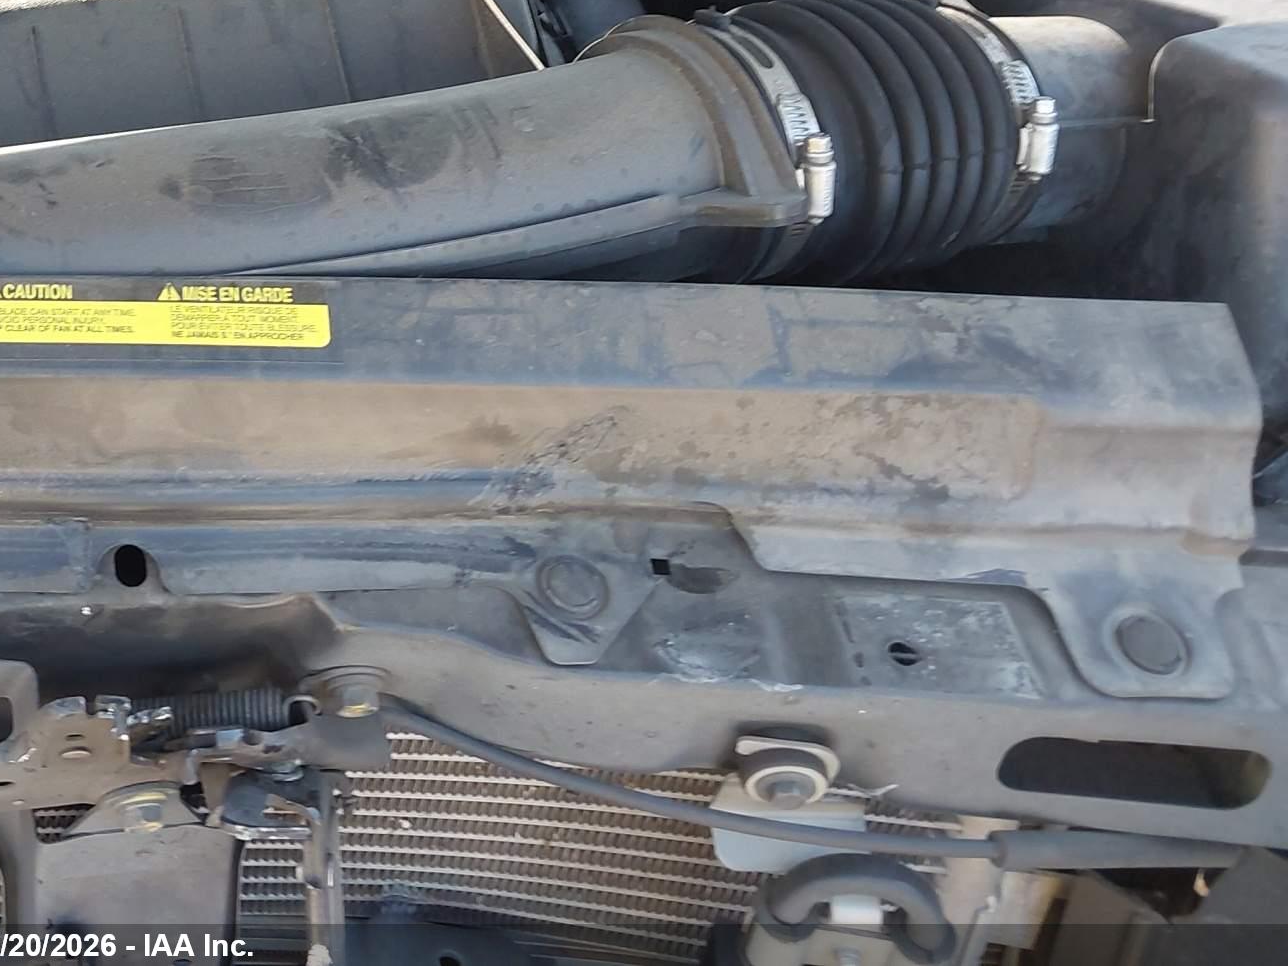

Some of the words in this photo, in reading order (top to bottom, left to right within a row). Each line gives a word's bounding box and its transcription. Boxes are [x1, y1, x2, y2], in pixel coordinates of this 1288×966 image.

[2, 284, 73, 299] CAUTION
[182, 286, 218, 301] MISE
[219, 286, 240, 301] EN
[241, 287, 294, 303] GARDE
